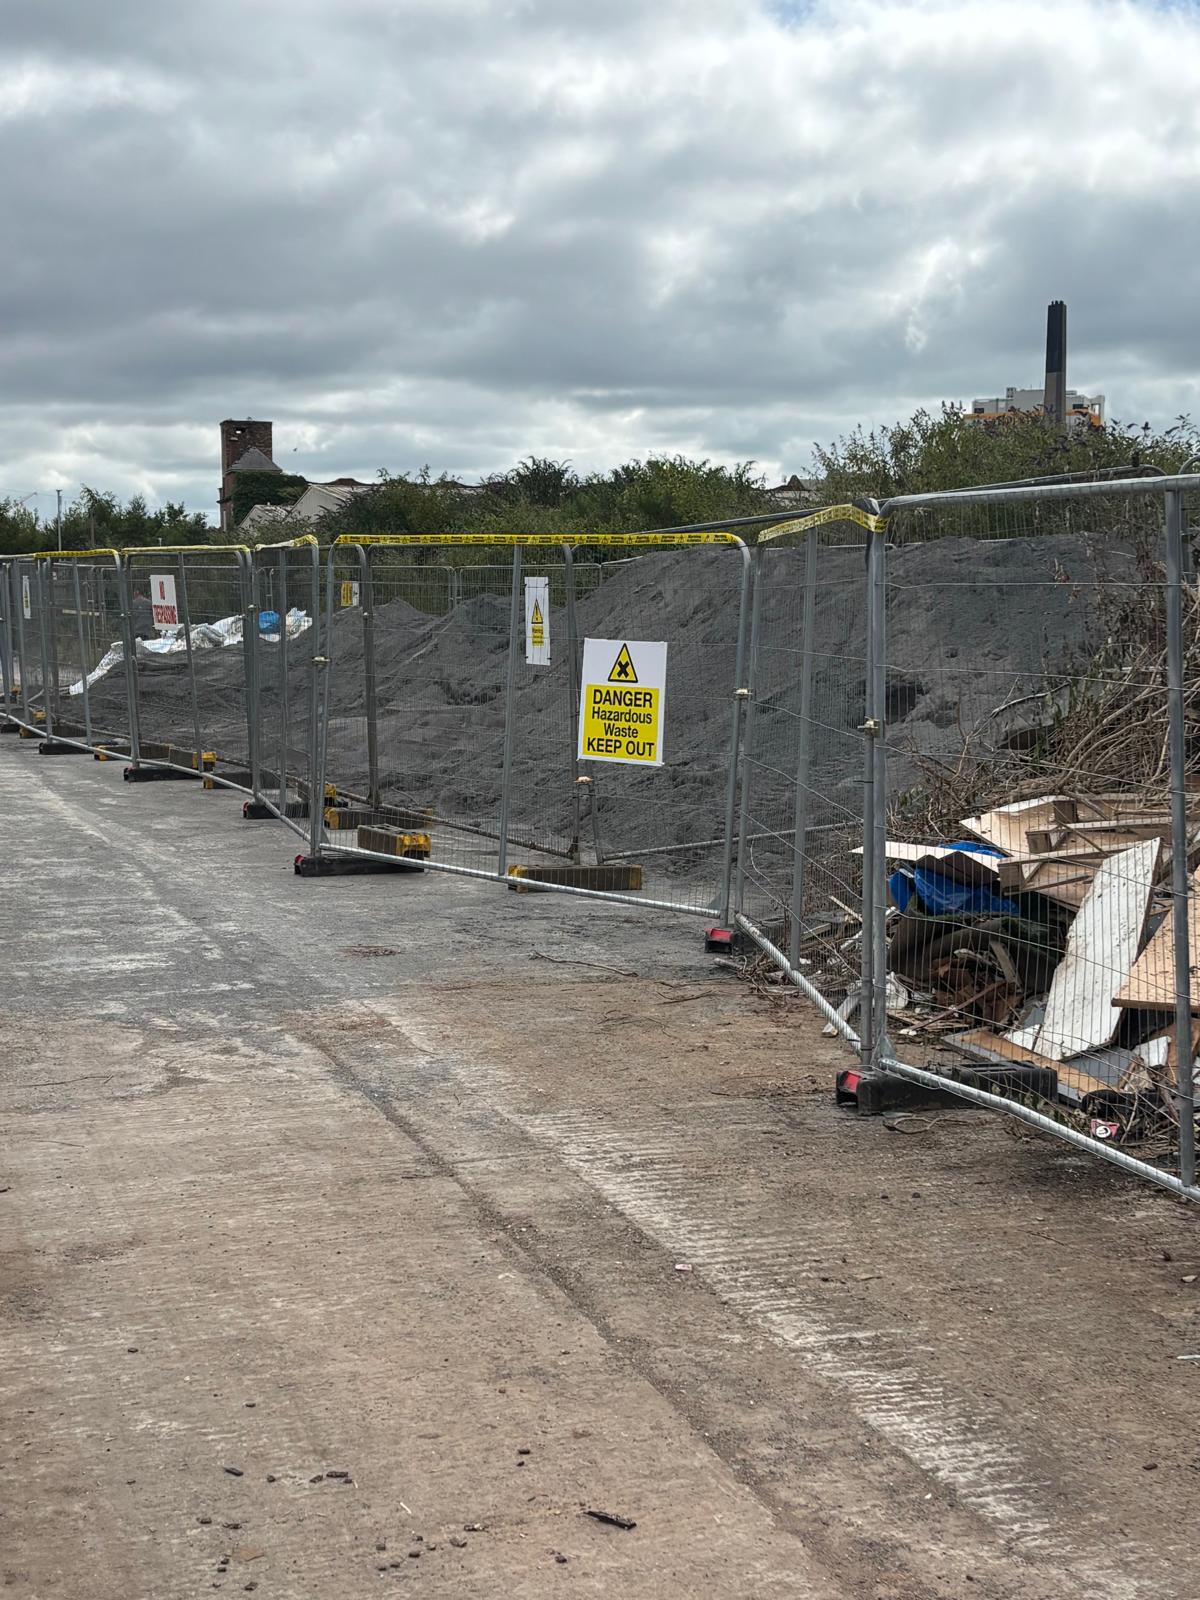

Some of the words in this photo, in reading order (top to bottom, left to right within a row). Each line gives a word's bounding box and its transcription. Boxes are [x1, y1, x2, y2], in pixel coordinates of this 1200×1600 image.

[593, 689, 653, 708] DANGER
[592, 706, 652, 724] Hazardous
[604, 722, 639, 738] Waste
[587, 737, 622, 753] KEEP
[625, 740, 655, 757] OUT
